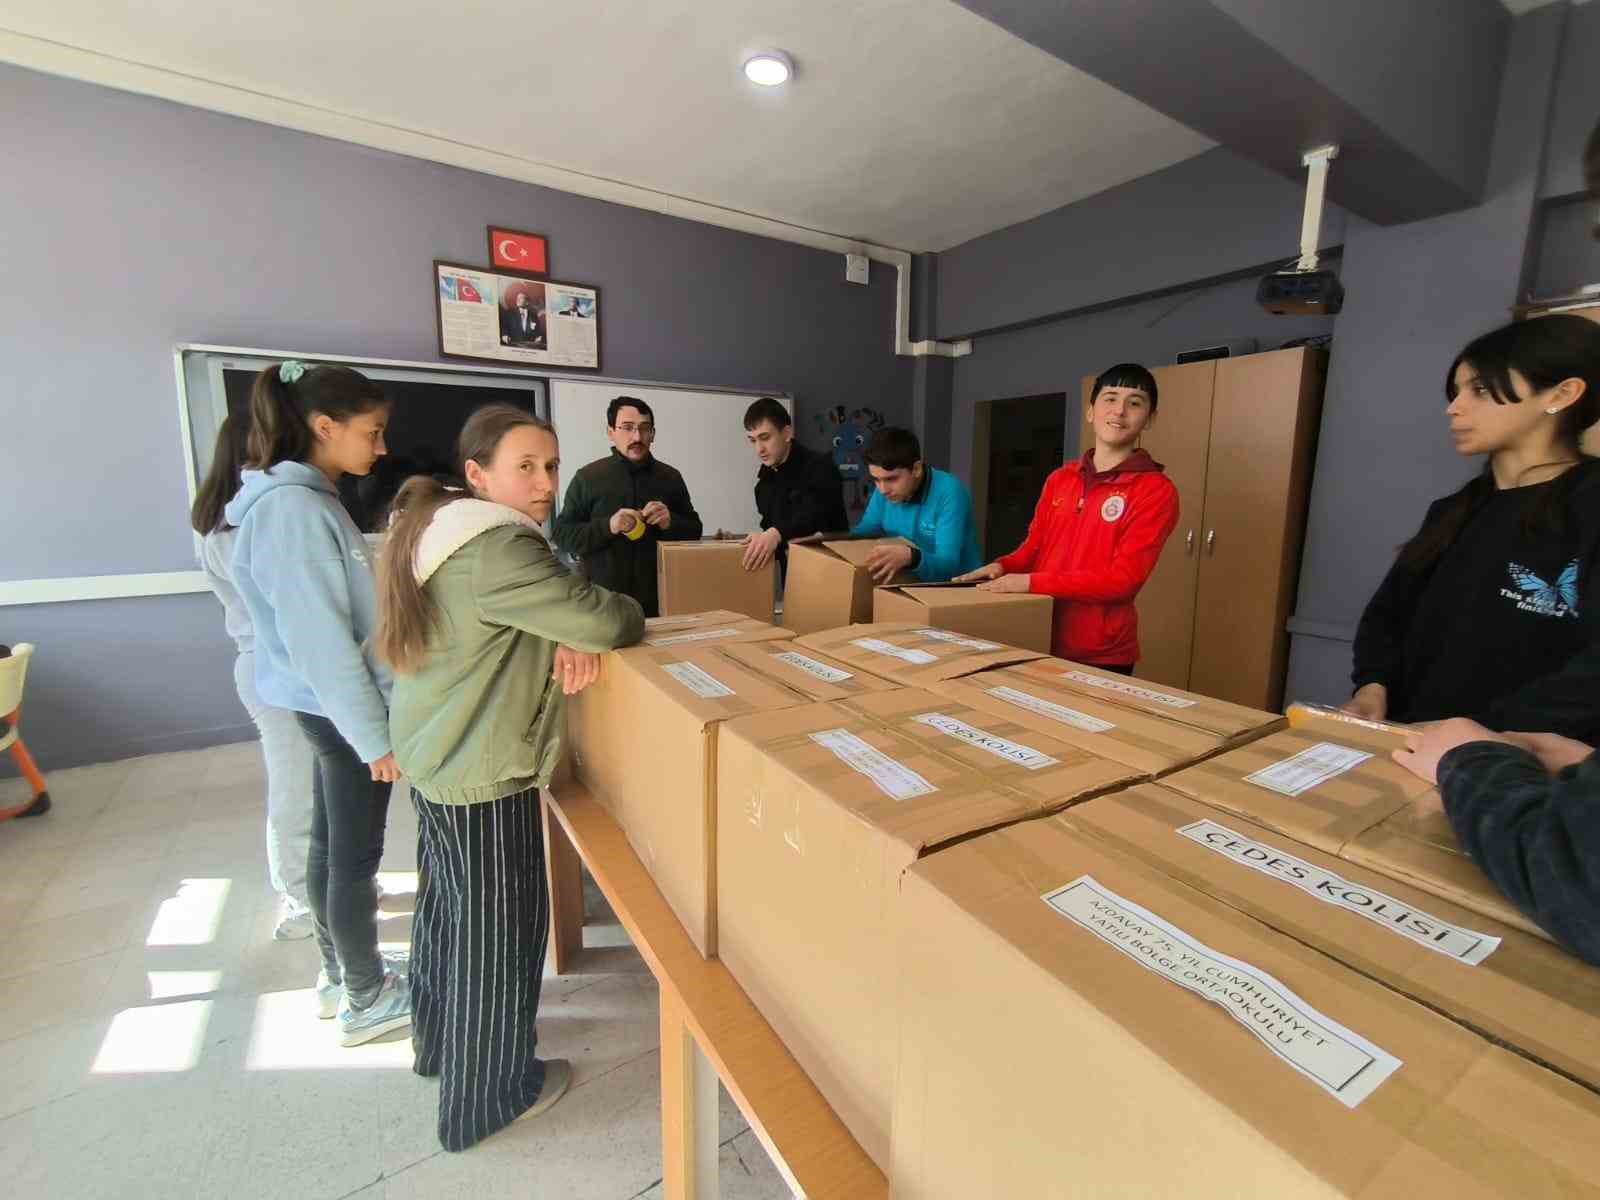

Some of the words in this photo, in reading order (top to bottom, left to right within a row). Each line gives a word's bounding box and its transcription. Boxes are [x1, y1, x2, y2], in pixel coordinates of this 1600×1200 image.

[1206, 832, 1310, 879] ÇEDES
[1316, 880, 1451, 942] KOLİSİ
[1089, 913, 1130, 941] YATILI
[1183, 970, 1294, 1044] ORTAOKULU
